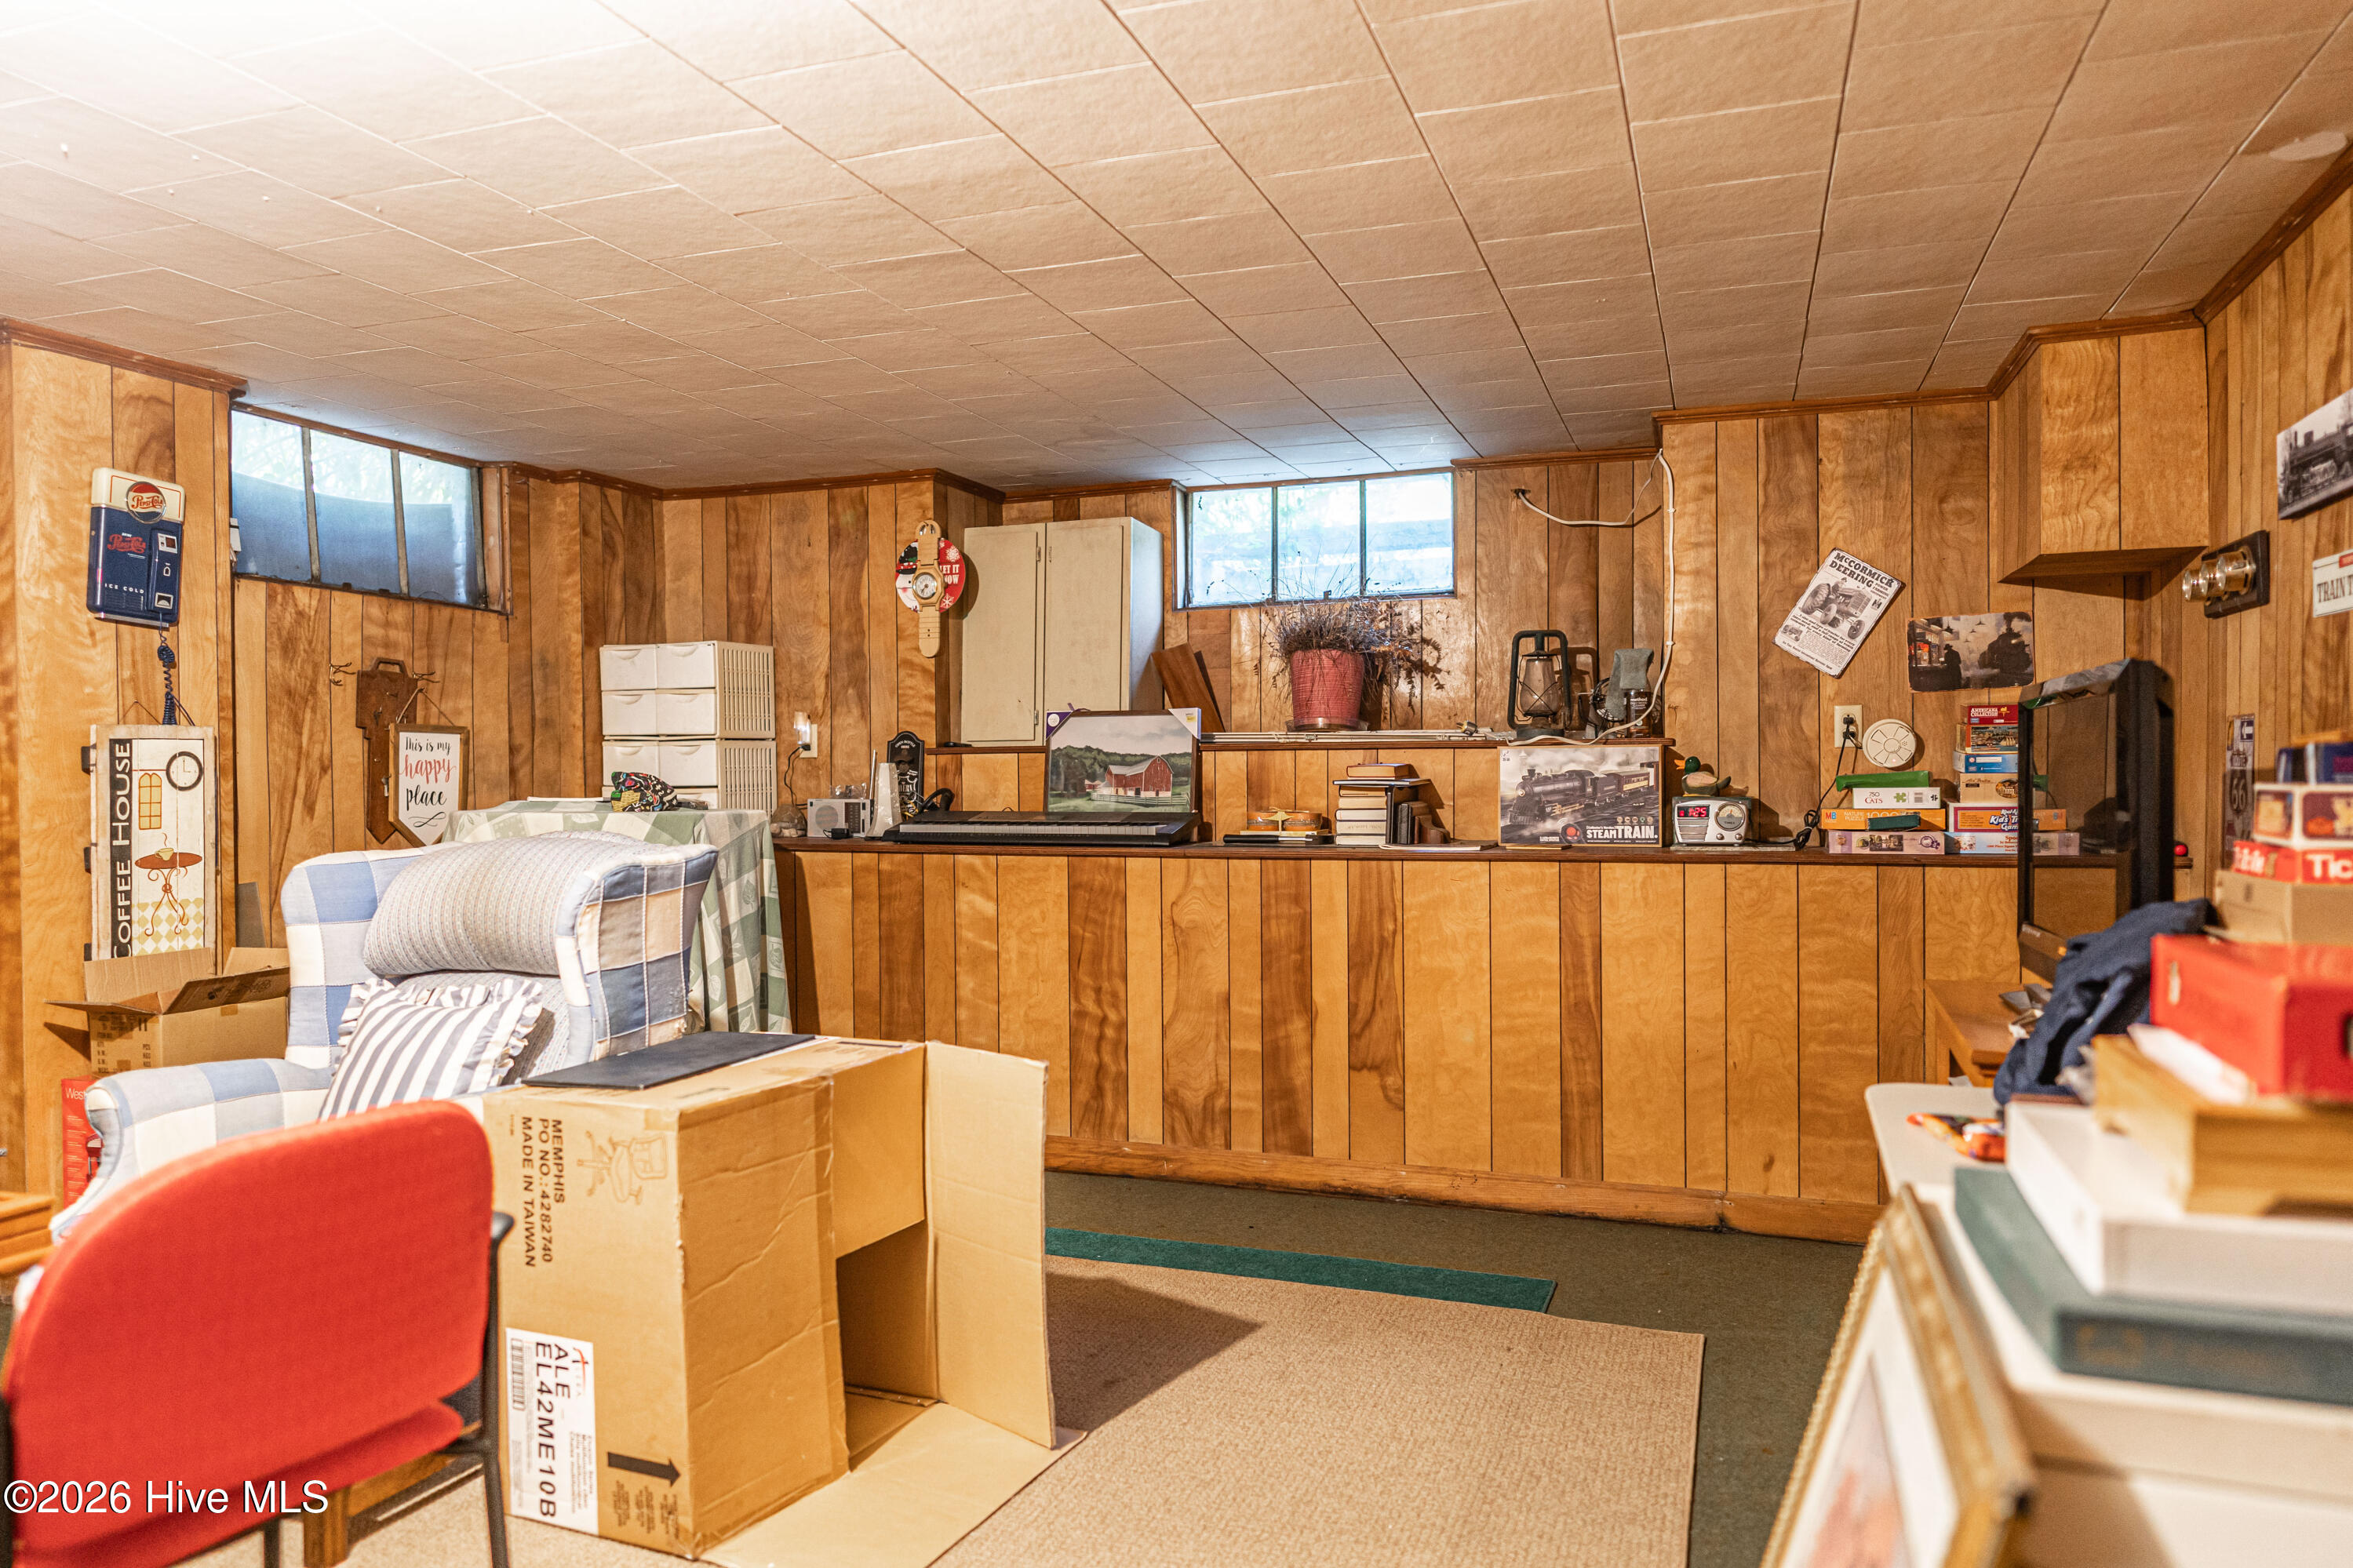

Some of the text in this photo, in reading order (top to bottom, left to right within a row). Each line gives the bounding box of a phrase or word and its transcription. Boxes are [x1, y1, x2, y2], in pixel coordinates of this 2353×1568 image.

[952, 564, 960, 573] IT
[1829, 560, 1874, 588] DEERING
[1834, 552, 1895, 588] McCORMICK
[2316, 577, 2345, 603] TRAIN
[406, 737, 451, 755] This is my
[399, 755, 457, 784] happy
[406, 784, 447, 811] place
[1825, 811, 1837, 820] MB
[1586, 829, 1616, 839] STEAM
[112, 743, 132, 959] COFFEE HOUSE
[538, 1118, 549, 1144] PO
[552, 1119, 565, 1203] MEMPHIS
[522, 1116, 536, 1268] MADE IN TAIWAN
[554, 1344, 570, 1399] ALE
[536, 1341, 556, 1517] EL42ME10B
